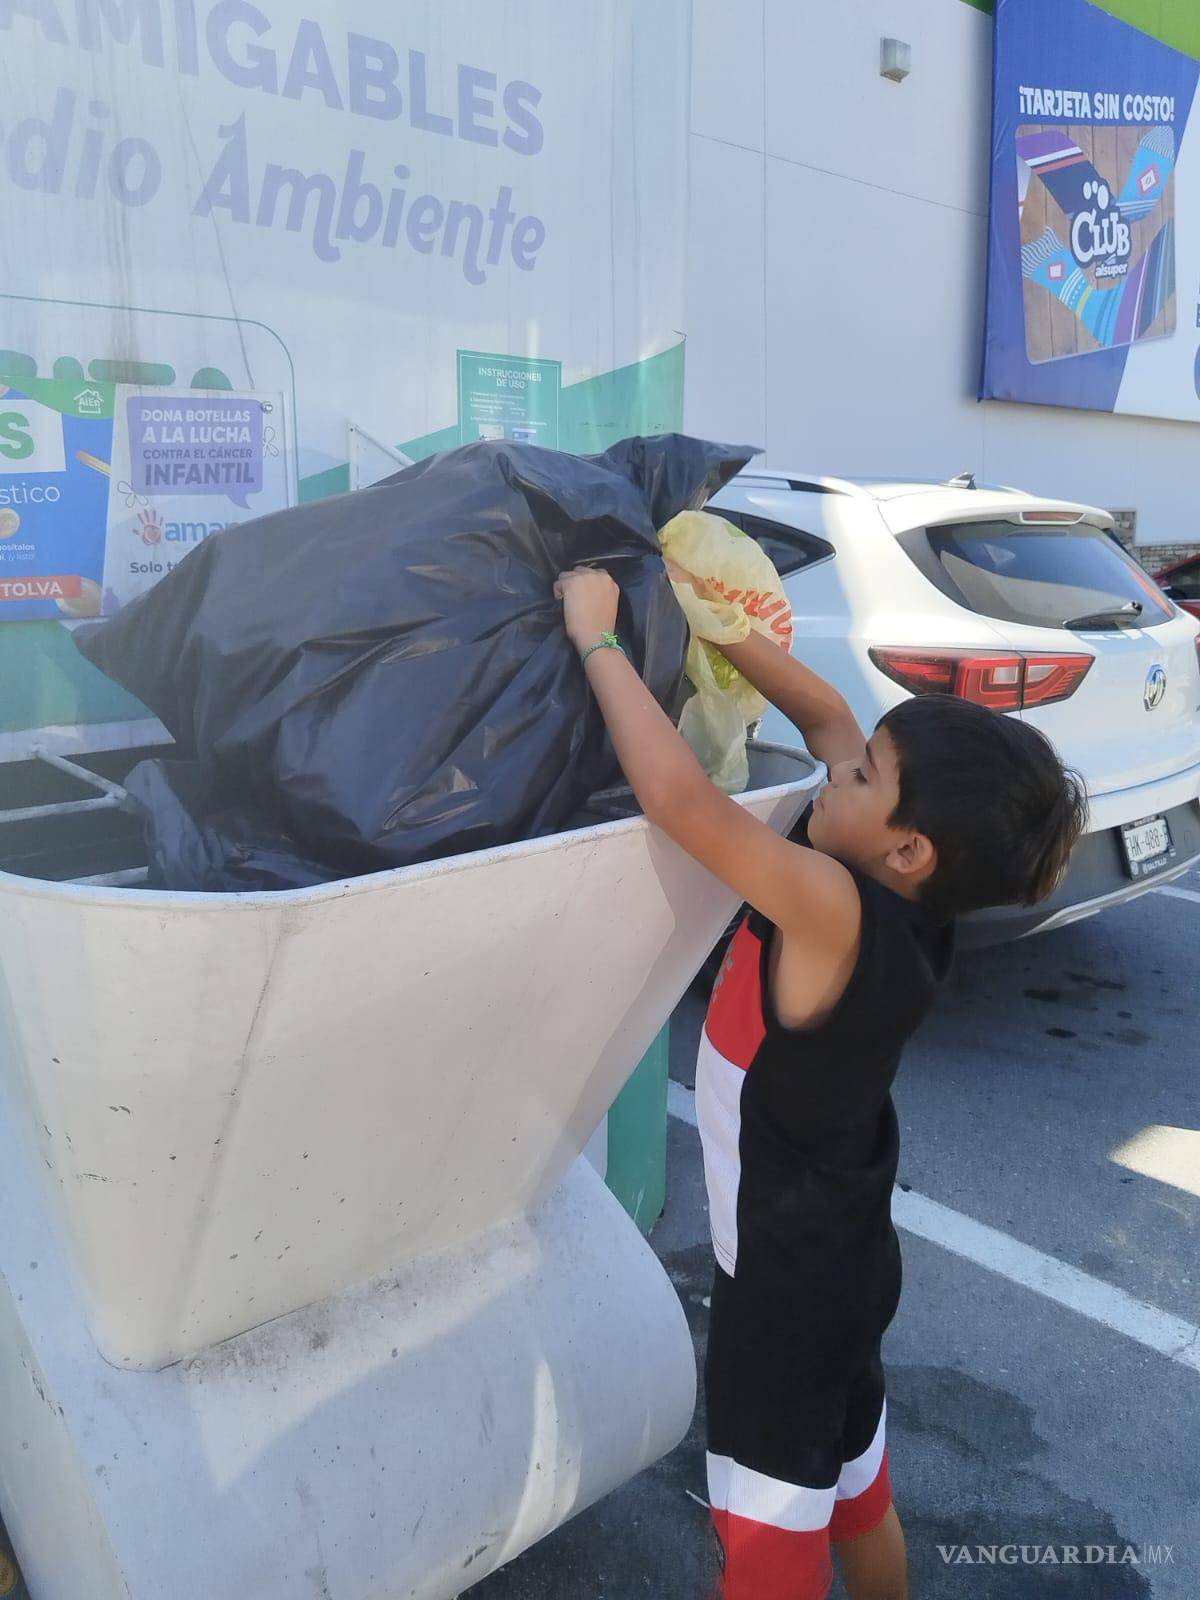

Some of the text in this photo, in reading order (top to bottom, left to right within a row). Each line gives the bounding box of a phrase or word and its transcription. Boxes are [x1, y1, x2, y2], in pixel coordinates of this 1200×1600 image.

[1018, 85, 1175, 122] ¡TARJETA SIN COSTO!
[478, 367, 542, 382] INSTRUCCIONES
[496, 377, 526, 389] DE USO
[141, 409, 251, 422] DONA BOTELLAS
[142, 426, 252, 443] A LA LUCHA
[143, 446, 253, 460] CONTRA EL CÁNCER
[145, 462, 255, 486] INFANTIL
[130, 561, 162, 573] Solo
[1, 581, 64, 597] TOLVA
